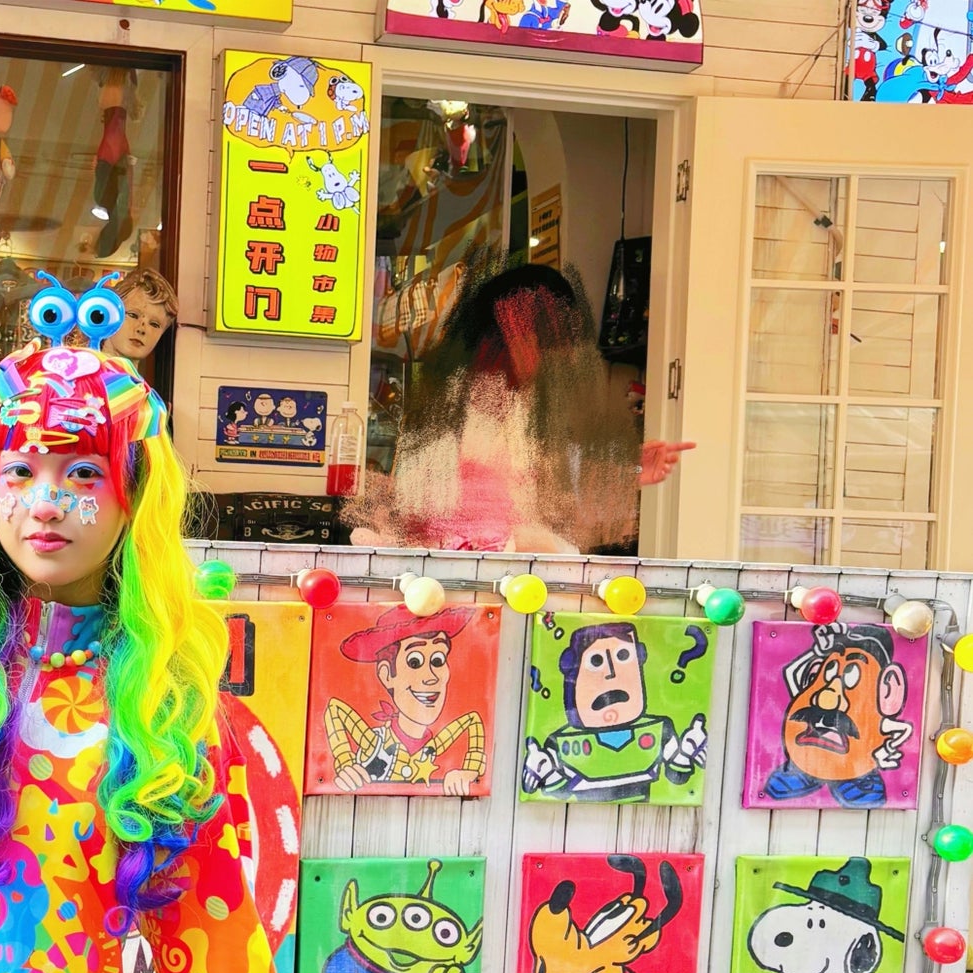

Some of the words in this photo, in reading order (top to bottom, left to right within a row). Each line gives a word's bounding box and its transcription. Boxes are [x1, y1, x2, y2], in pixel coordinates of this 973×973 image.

[223, 101, 276, 142] OPEN
[281, 121, 313, 147] AT
[244, 160, 289, 321] 一点开门
